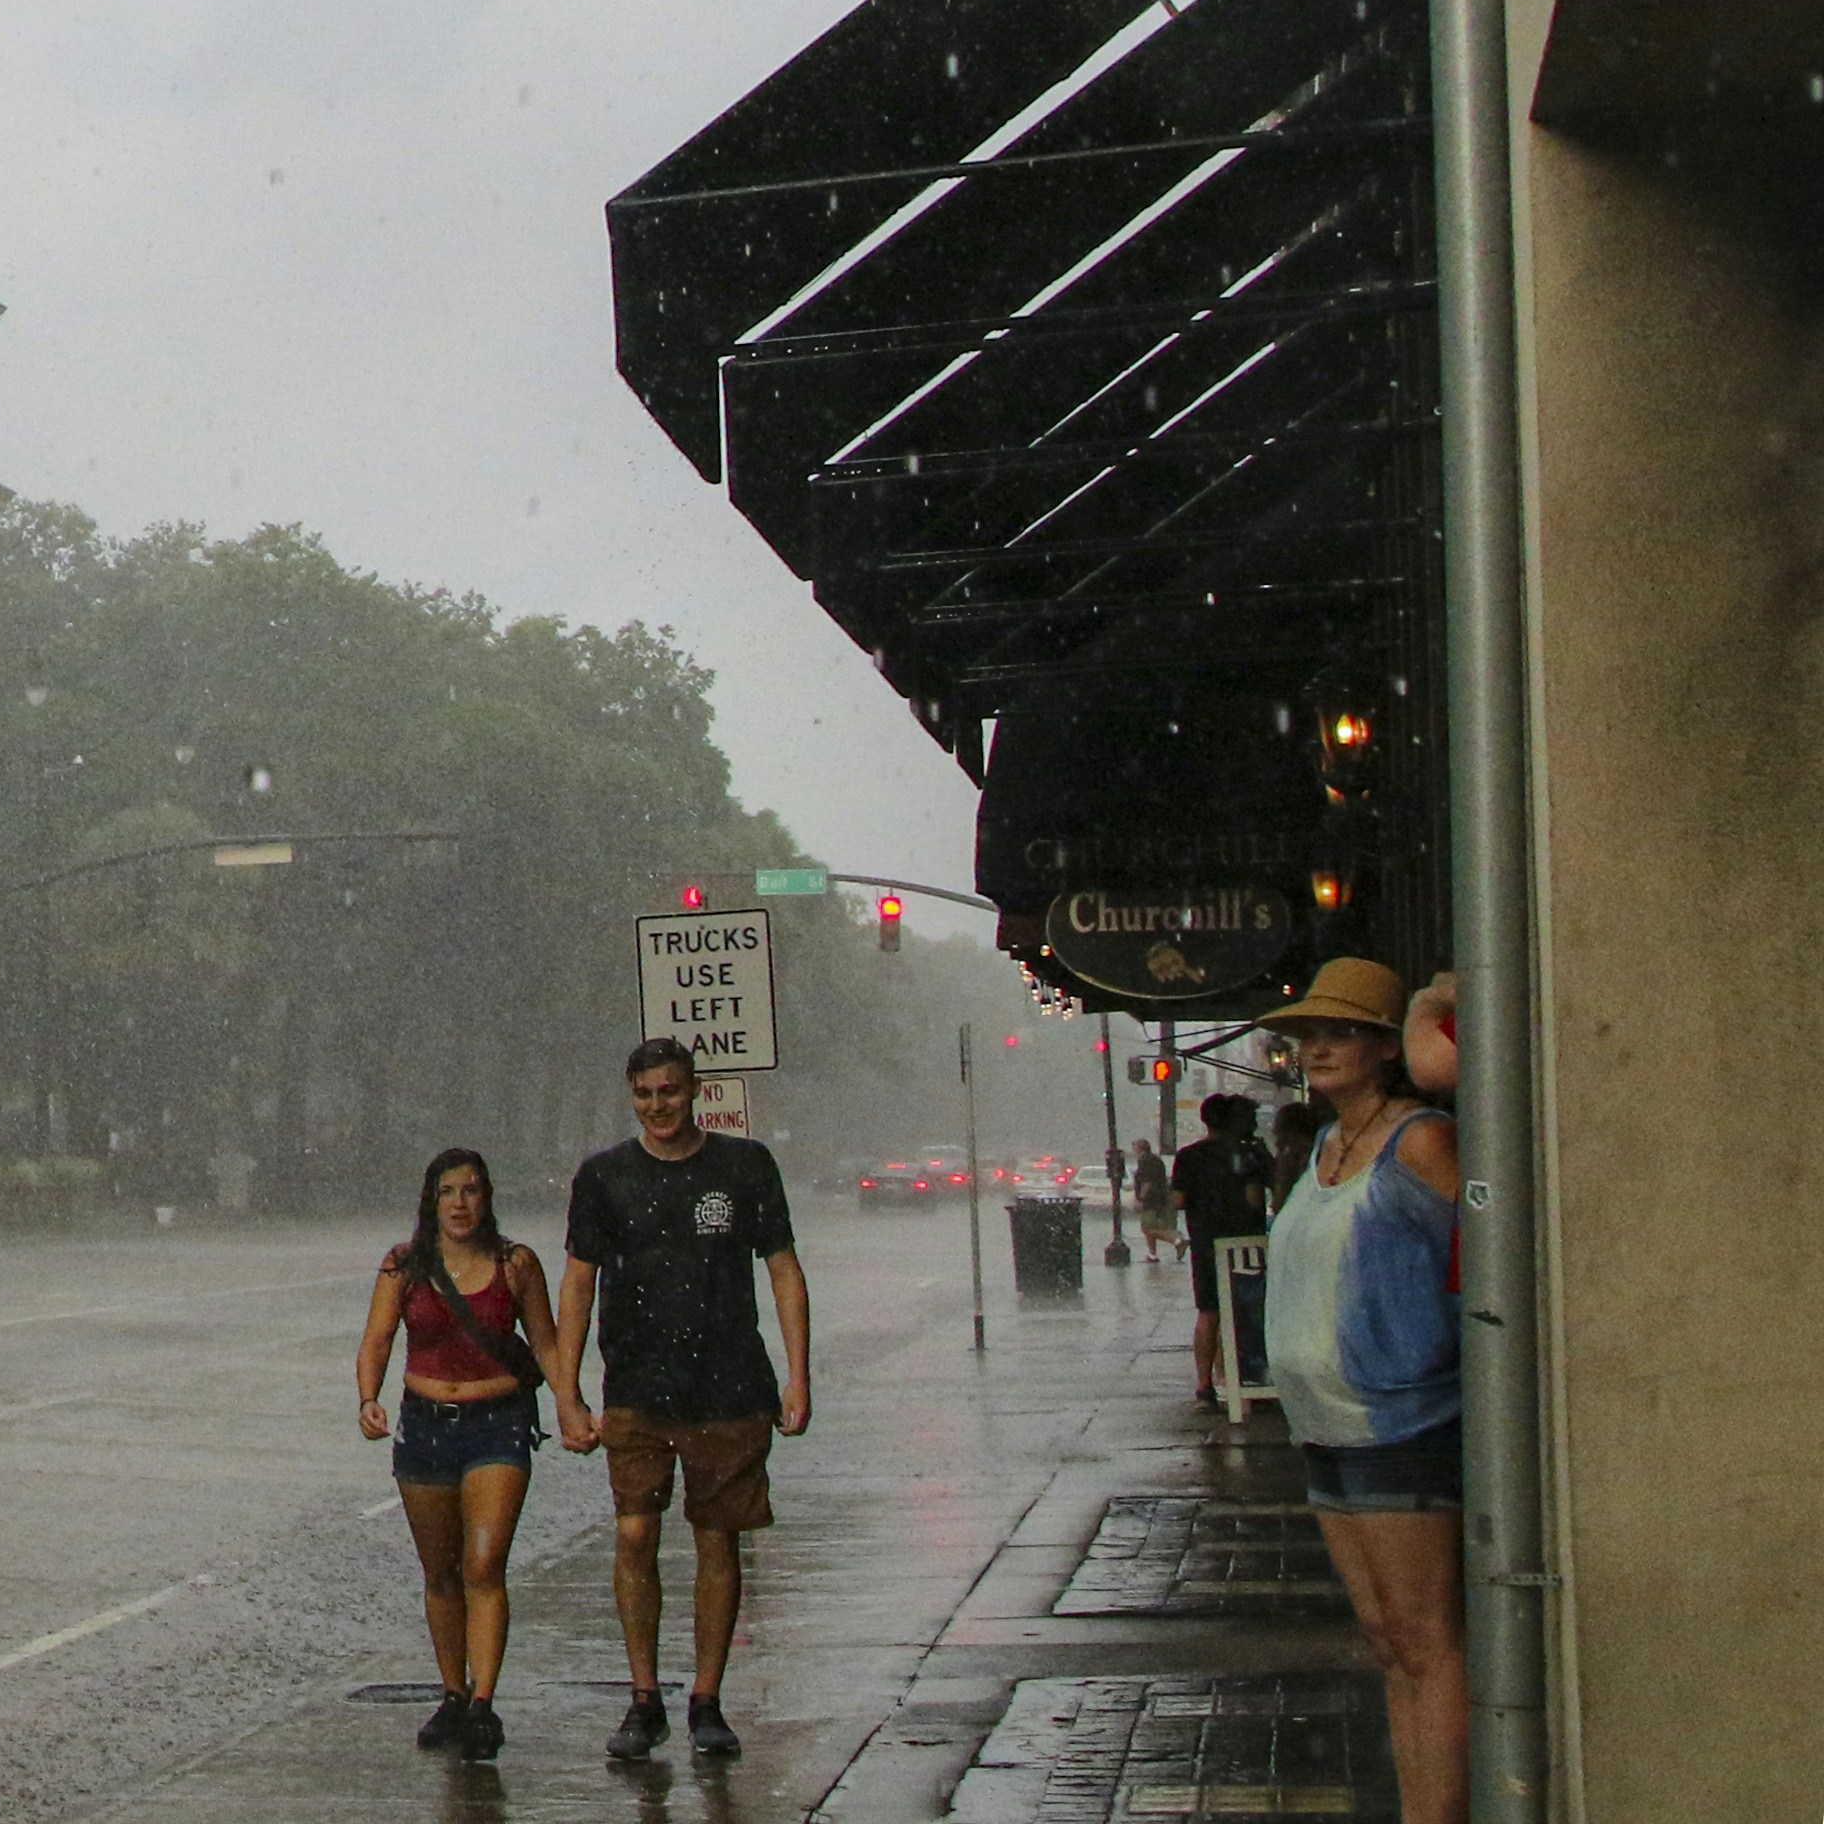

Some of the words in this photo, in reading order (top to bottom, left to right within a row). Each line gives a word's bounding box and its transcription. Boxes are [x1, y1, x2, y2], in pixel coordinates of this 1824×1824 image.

[1069, 889, 1272, 933] Churchill's
[649, 927, 759, 955] TRUCKS
[676, 963, 734, 988] USE
[671, 996, 743, 1023] LEFT
[672, 1031, 748, 1055] ANE
[703, 1084, 723, 1102] NO
[697, 1111, 745, 1130] ARKING
